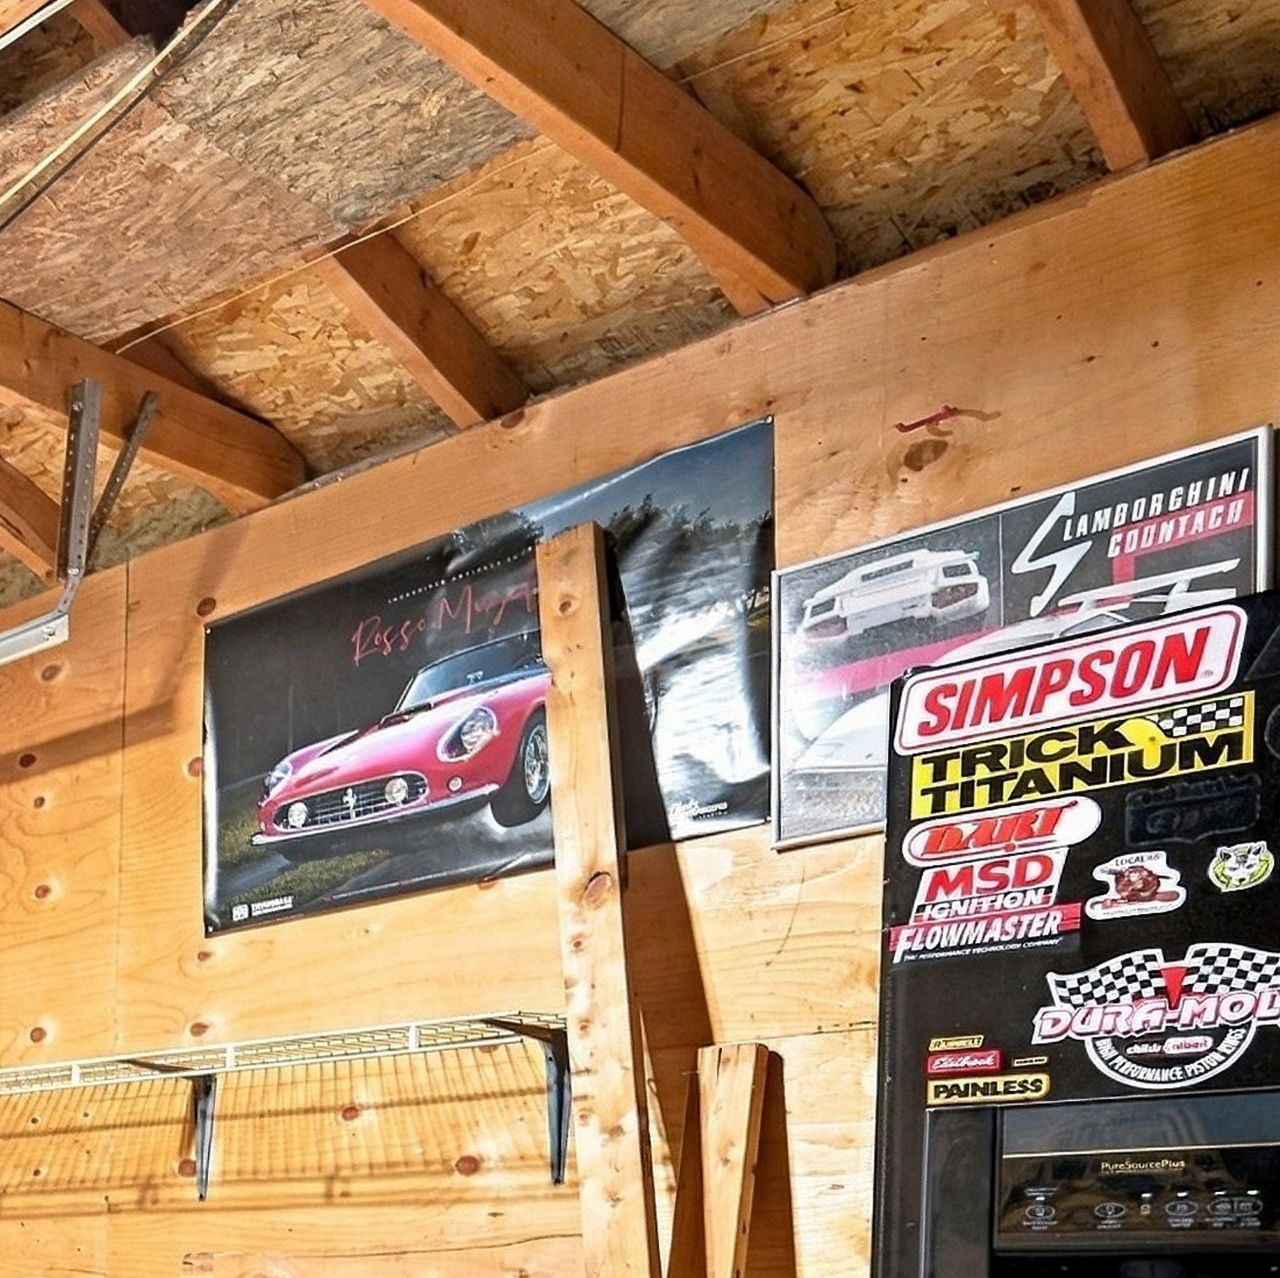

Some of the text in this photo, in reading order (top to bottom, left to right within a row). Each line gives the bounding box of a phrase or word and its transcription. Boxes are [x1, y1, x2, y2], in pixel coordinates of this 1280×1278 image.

[1063, 468, 1249, 542] LAMBORGHINI
[1107, 498, 1244, 558] COUNTACH
[917, 626, 1211, 737] SIMPSON
[921, 719, 1135, 783] TRICK
[921, 731, 1243, 814] TITANIUM
[922, 801, 1078, 854] DART
[924, 888, 1042, 919] IGNITION
[926, 854, 1054, 903] MSD
[893, 911, 1063, 964] FLOWMASTER
[1039, 990, 1280, 1039] DURA-MOL
[934, 1078, 1043, 1099] PAINLESS
[1101, 1159, 1185, 1171] PureSourcePlus
